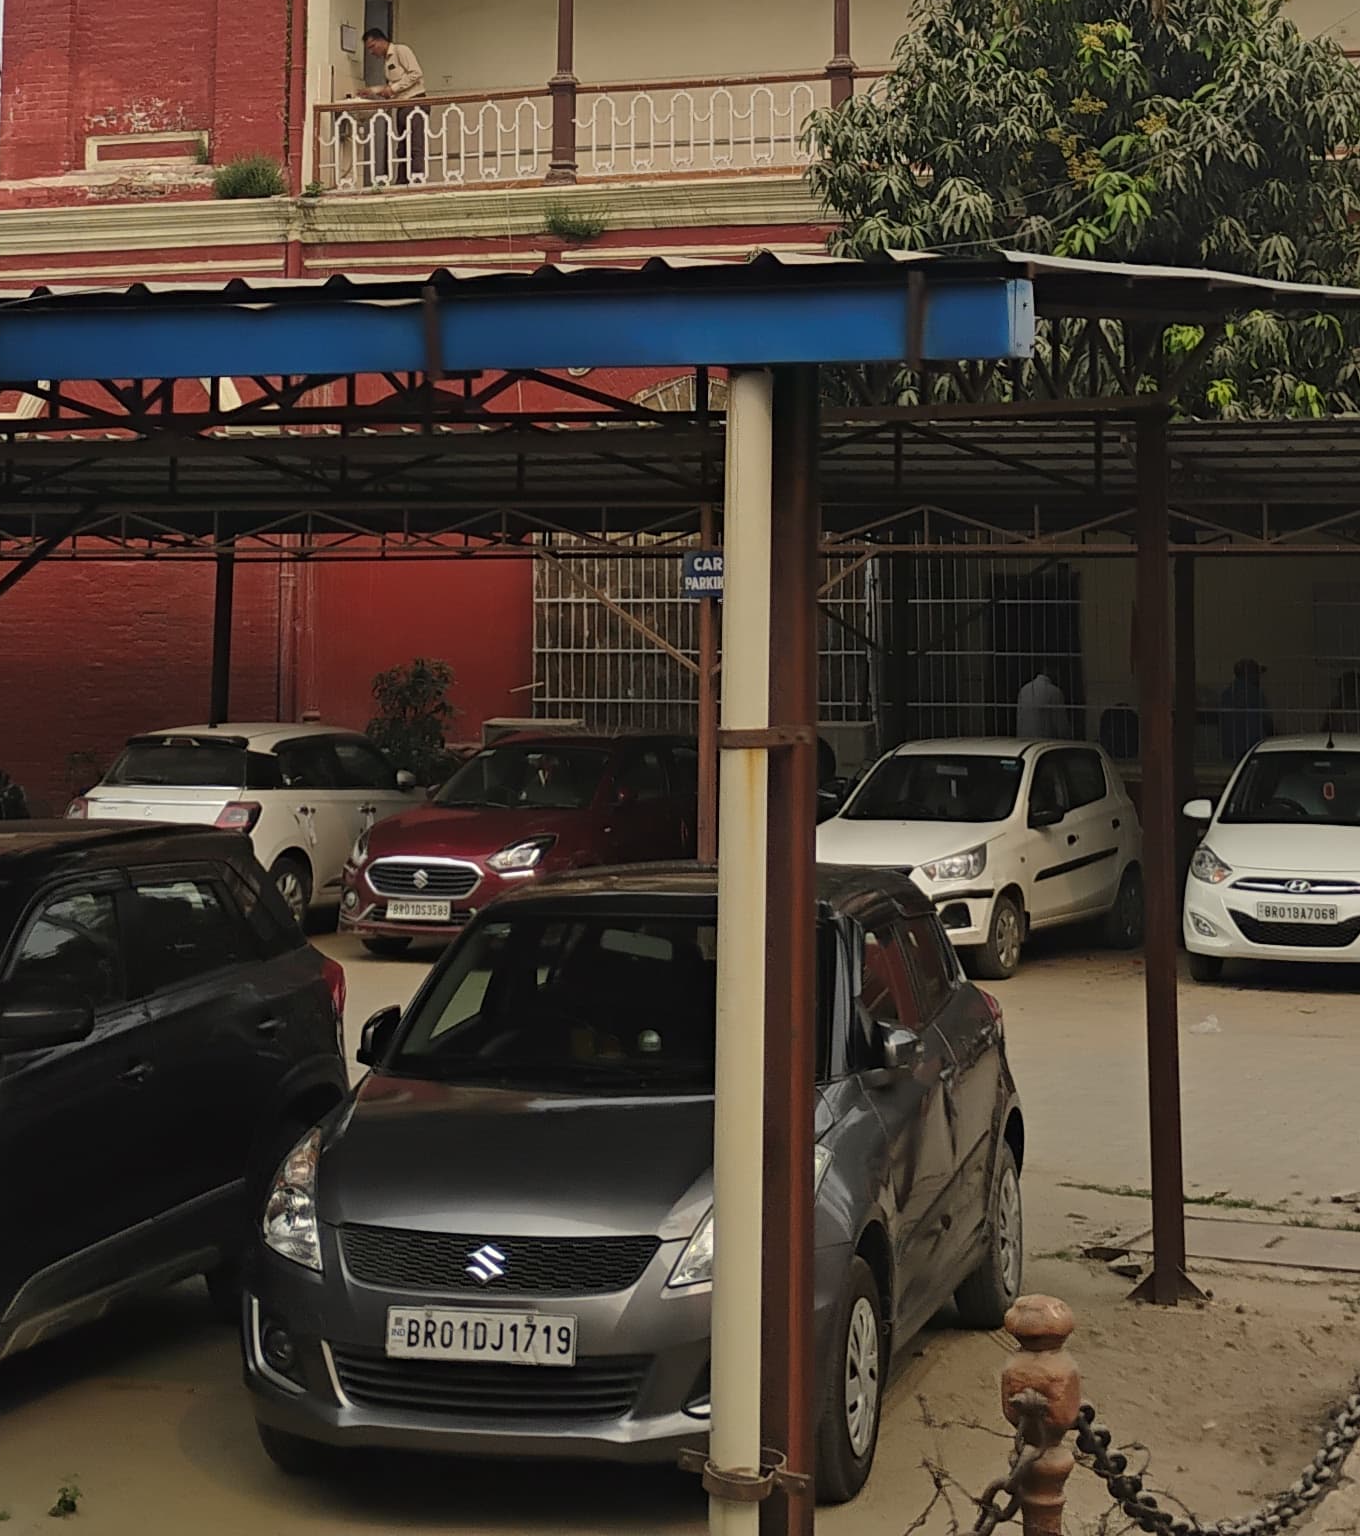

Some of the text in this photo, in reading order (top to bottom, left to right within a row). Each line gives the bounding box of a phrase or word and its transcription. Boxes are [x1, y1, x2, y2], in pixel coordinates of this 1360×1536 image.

[693, 557, 723, 571] CAR
[685, 575, 724, 590] PARKIN
[406, 1318, 572, 1355] BR01DJ1719
